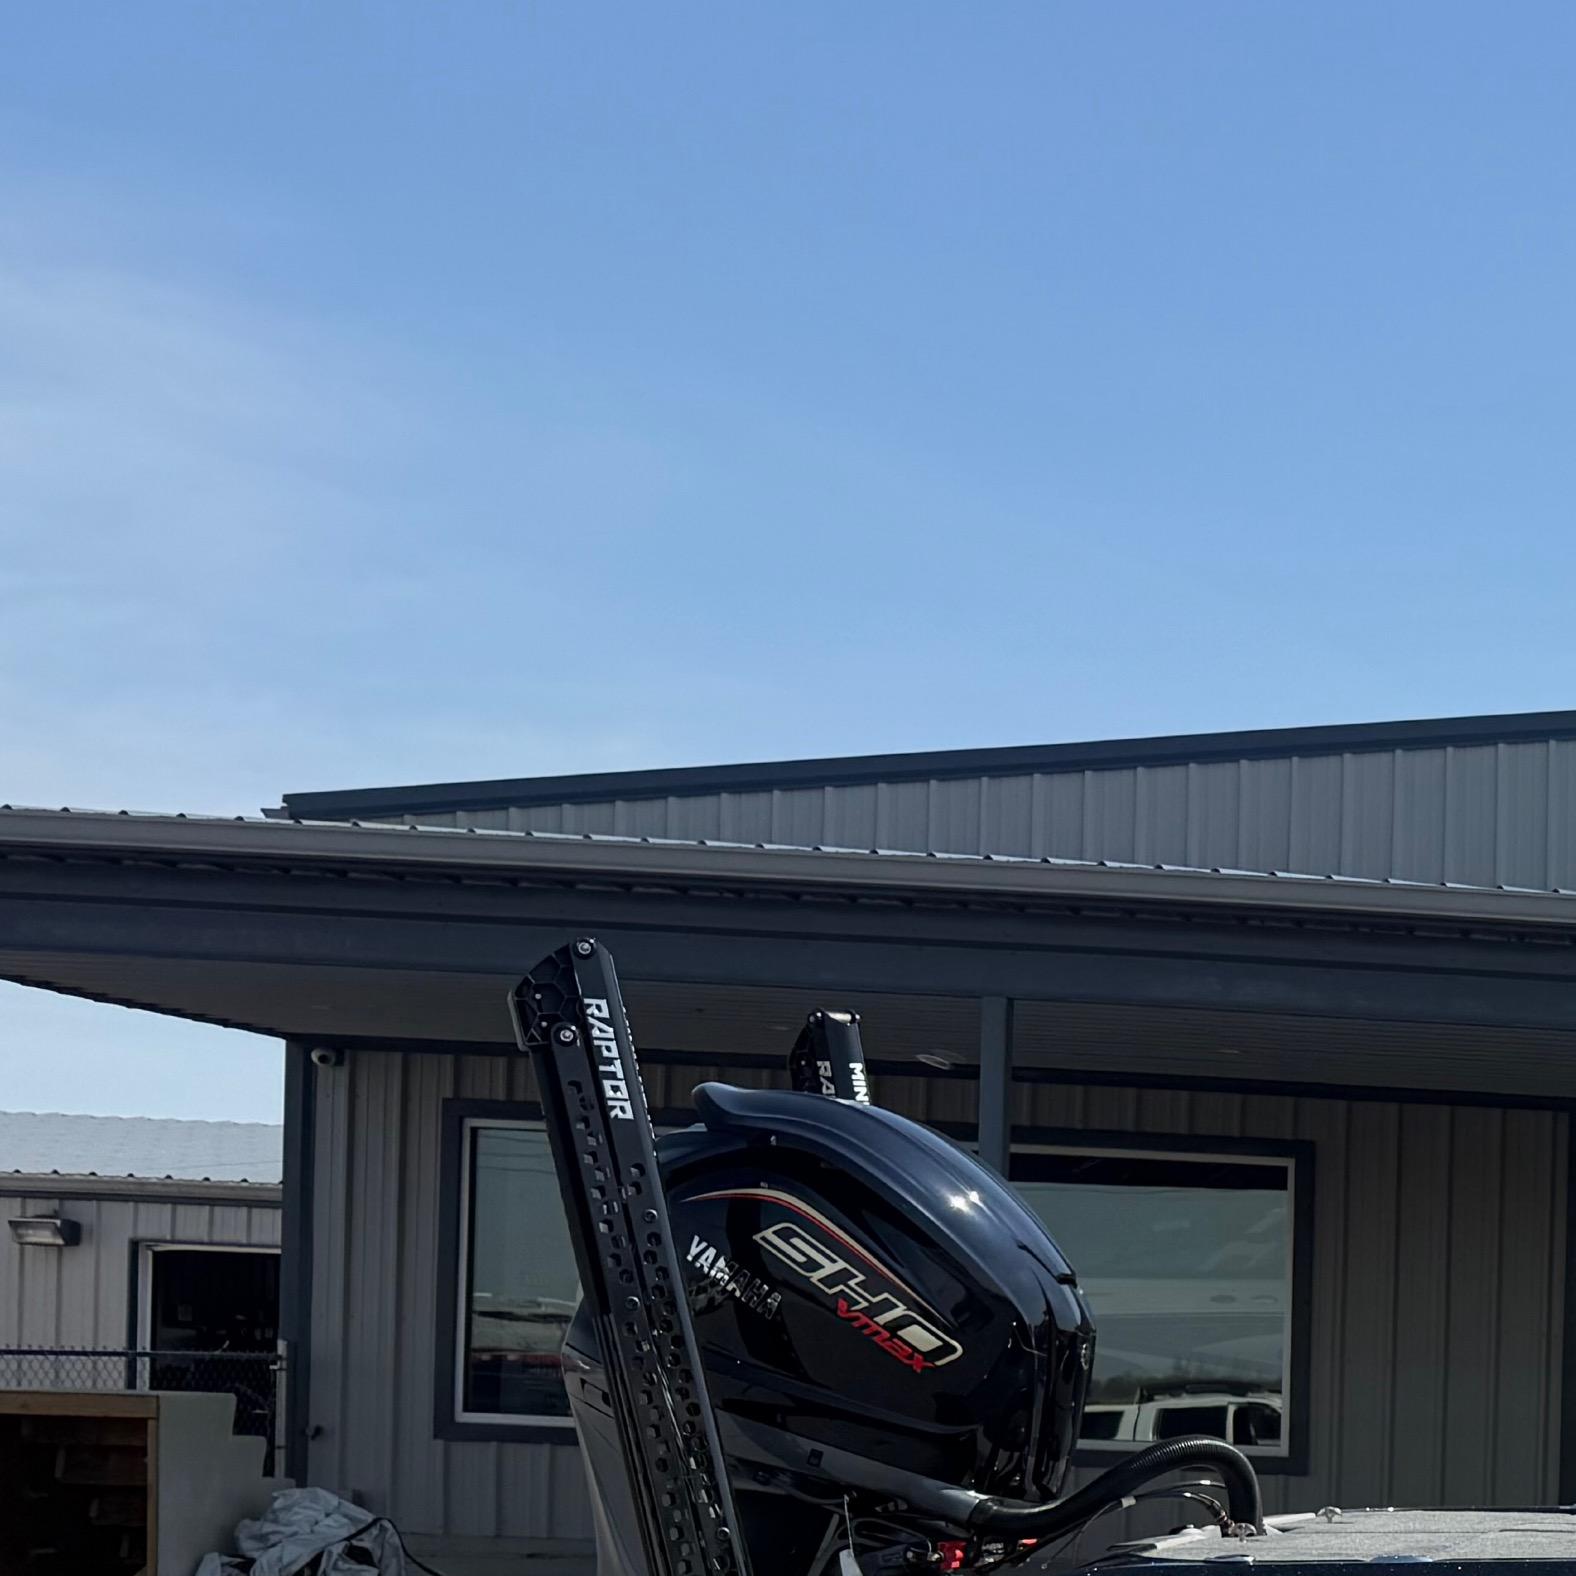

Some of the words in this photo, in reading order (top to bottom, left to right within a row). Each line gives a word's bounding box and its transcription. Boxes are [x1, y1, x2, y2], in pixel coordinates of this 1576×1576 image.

[583, 997, 635, 1121] RAPTOR
[848, 1062, 870, 1106] MIN
[685, 1234, 783, 1321] YAMAHA
[752, 1222, 964, 1367] SHO
